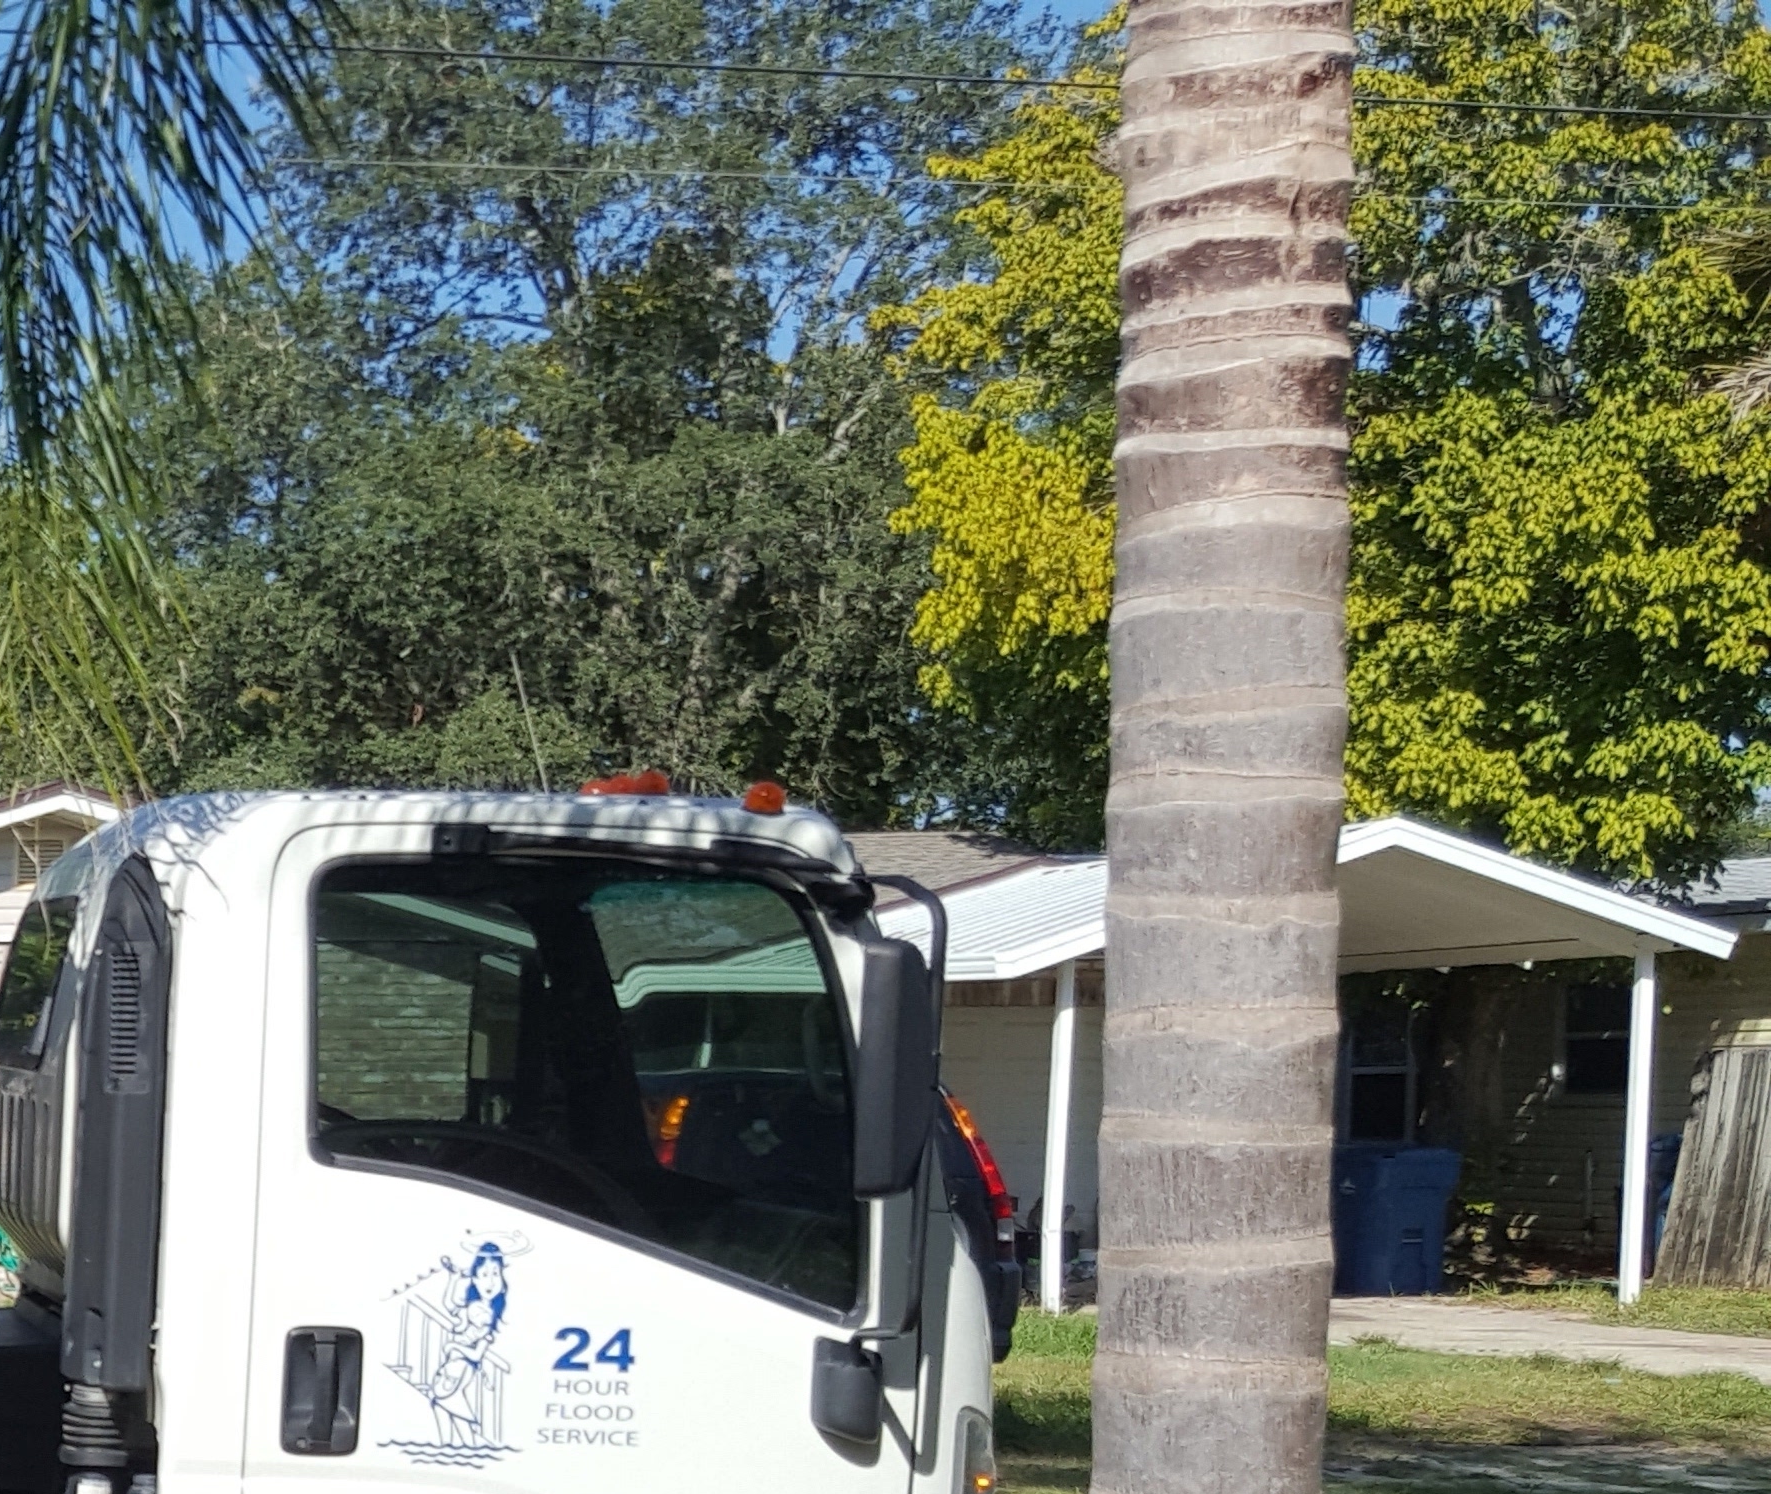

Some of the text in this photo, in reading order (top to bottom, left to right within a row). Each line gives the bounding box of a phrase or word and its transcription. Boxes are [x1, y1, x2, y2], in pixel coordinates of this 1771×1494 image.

[551, 1326, 636, 1373] 24
[553, 1379, 630, 1396] HOUR
[545, 1403, 635, 1421] FLOOD
[537, 1428, 640, 1447] SERVICE
